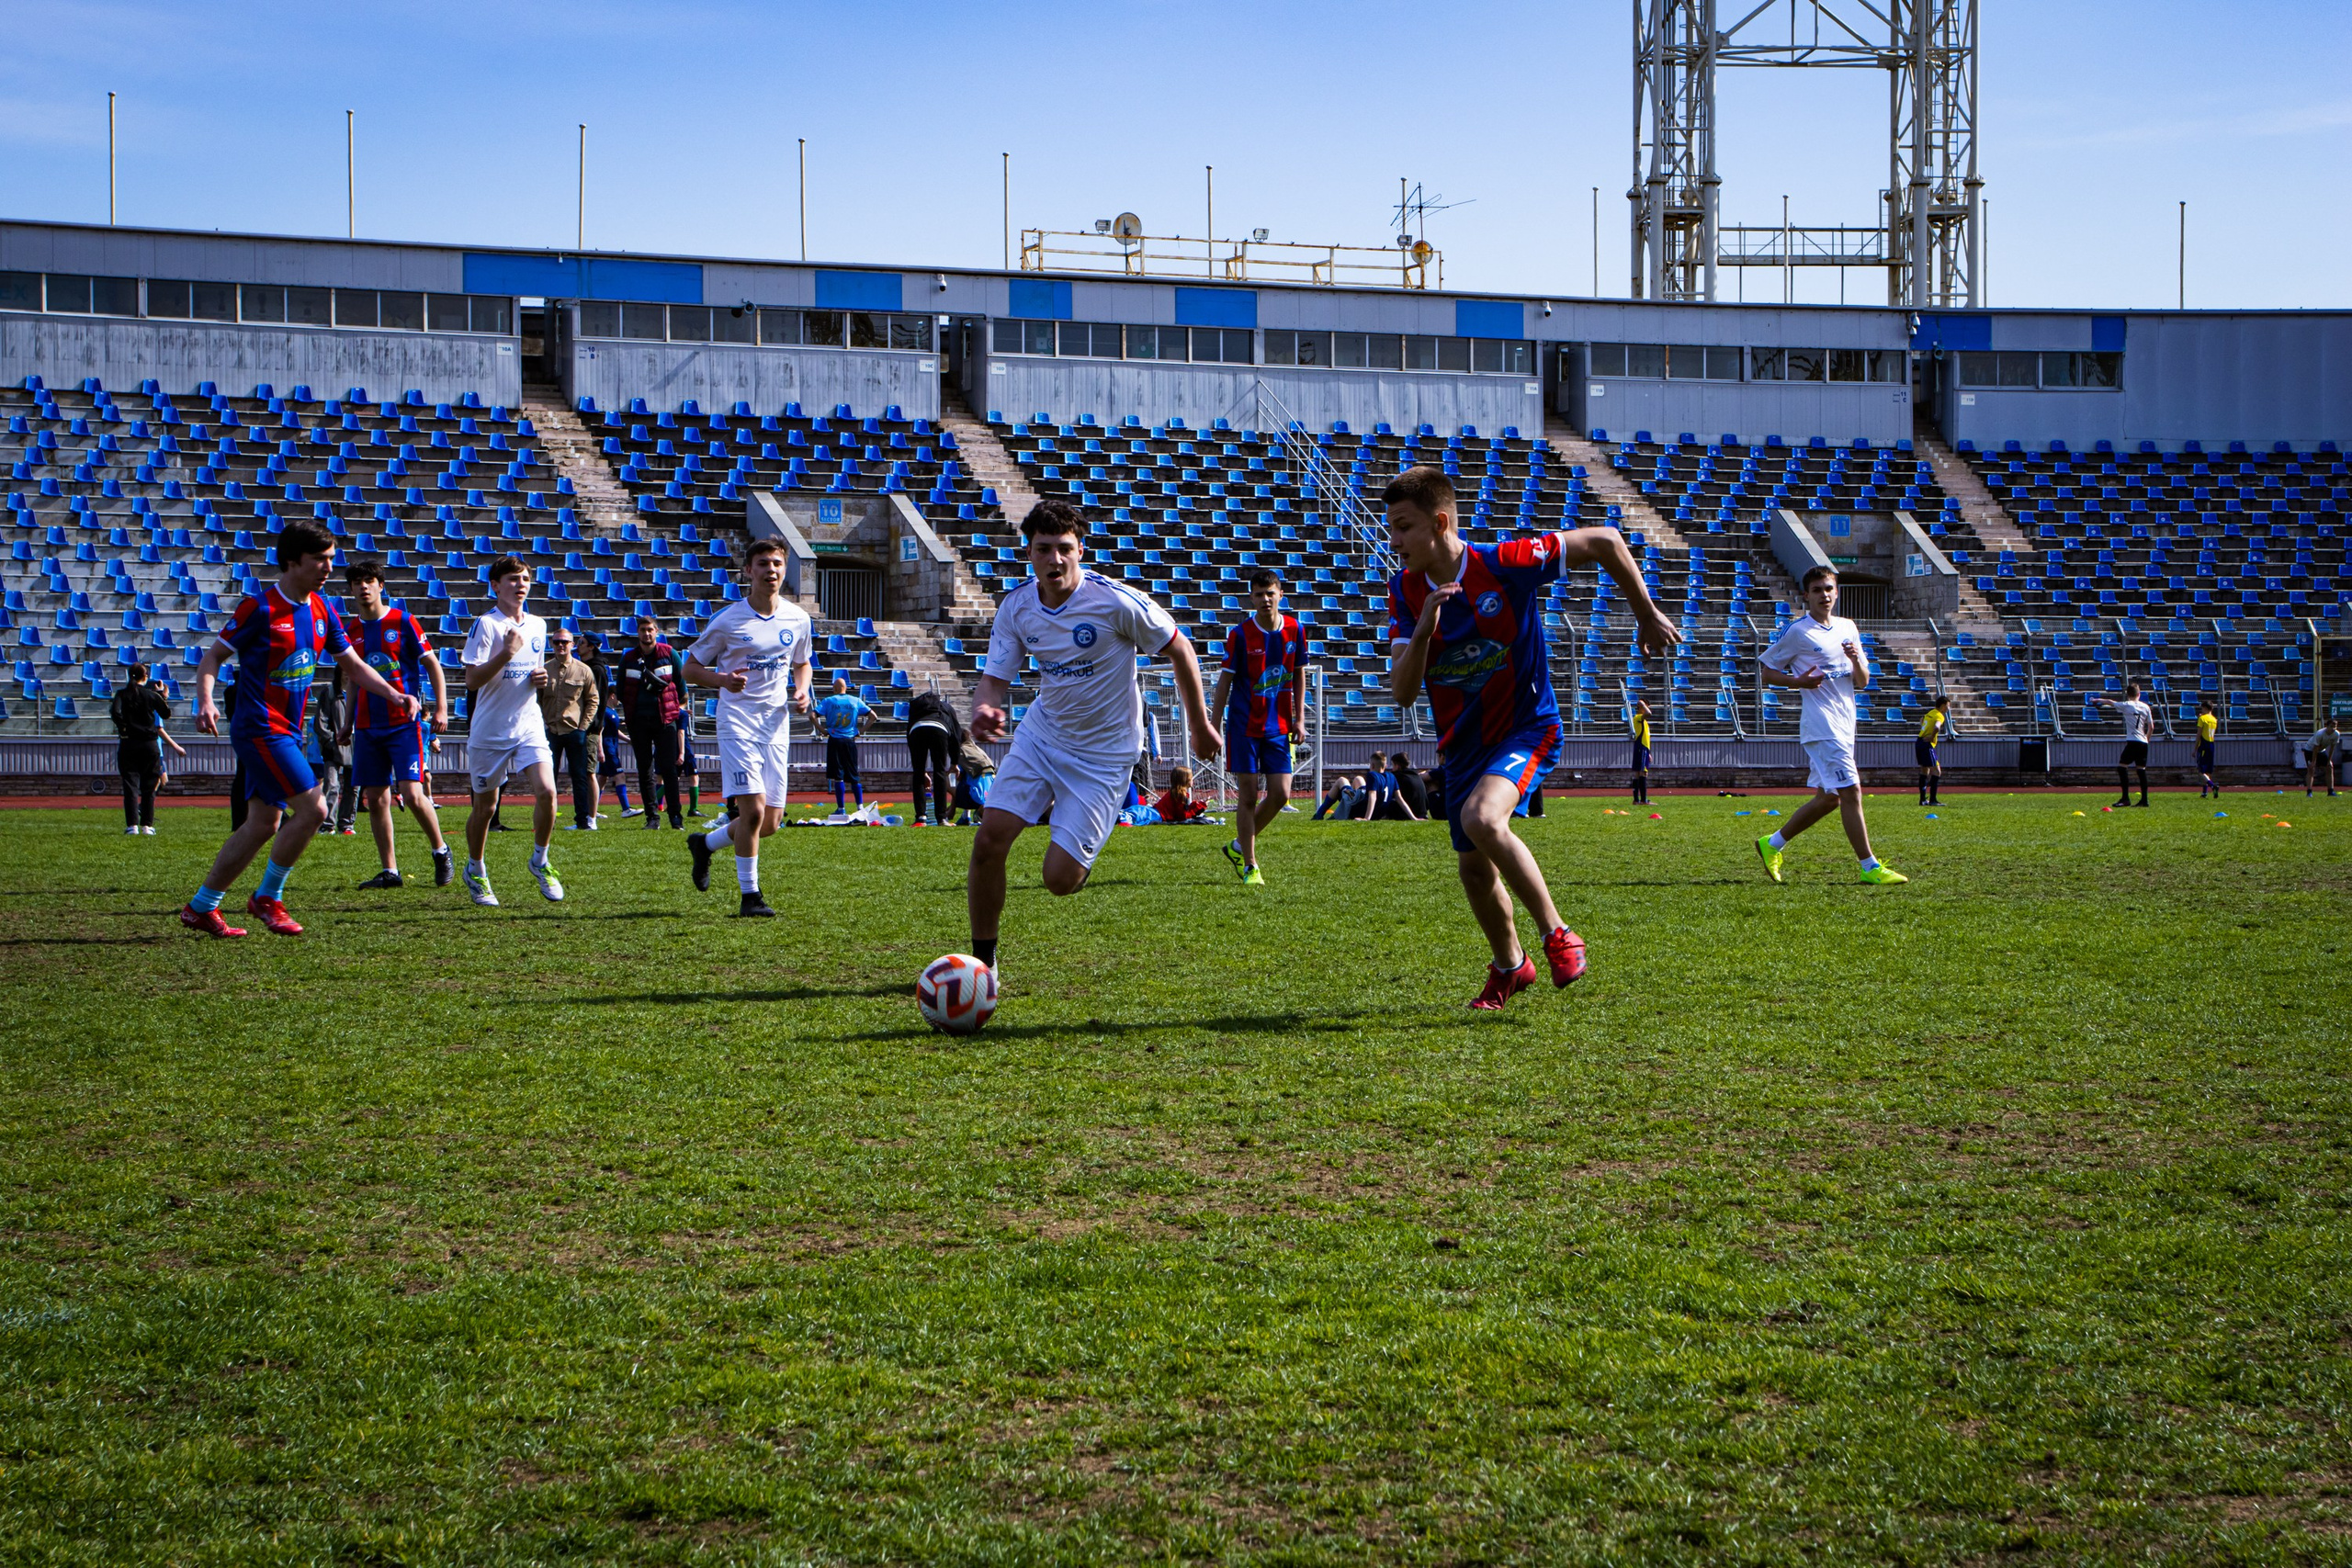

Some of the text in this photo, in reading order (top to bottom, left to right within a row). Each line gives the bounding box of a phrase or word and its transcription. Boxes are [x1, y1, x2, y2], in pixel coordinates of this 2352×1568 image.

[822, 504, 839, 517] 10
[1834, 520, 1847, 531] 11
[834, 712, 851, 728] 16
[2133, 712, 2141, 729] 7
[409, 761, 419, 774] 4
[1504, 752, 1527, 772] 7
[733, 771, 749, 785] 10
[1835, 769, 1847, 782] 11
[1383, 785, 1389, 802] 1
